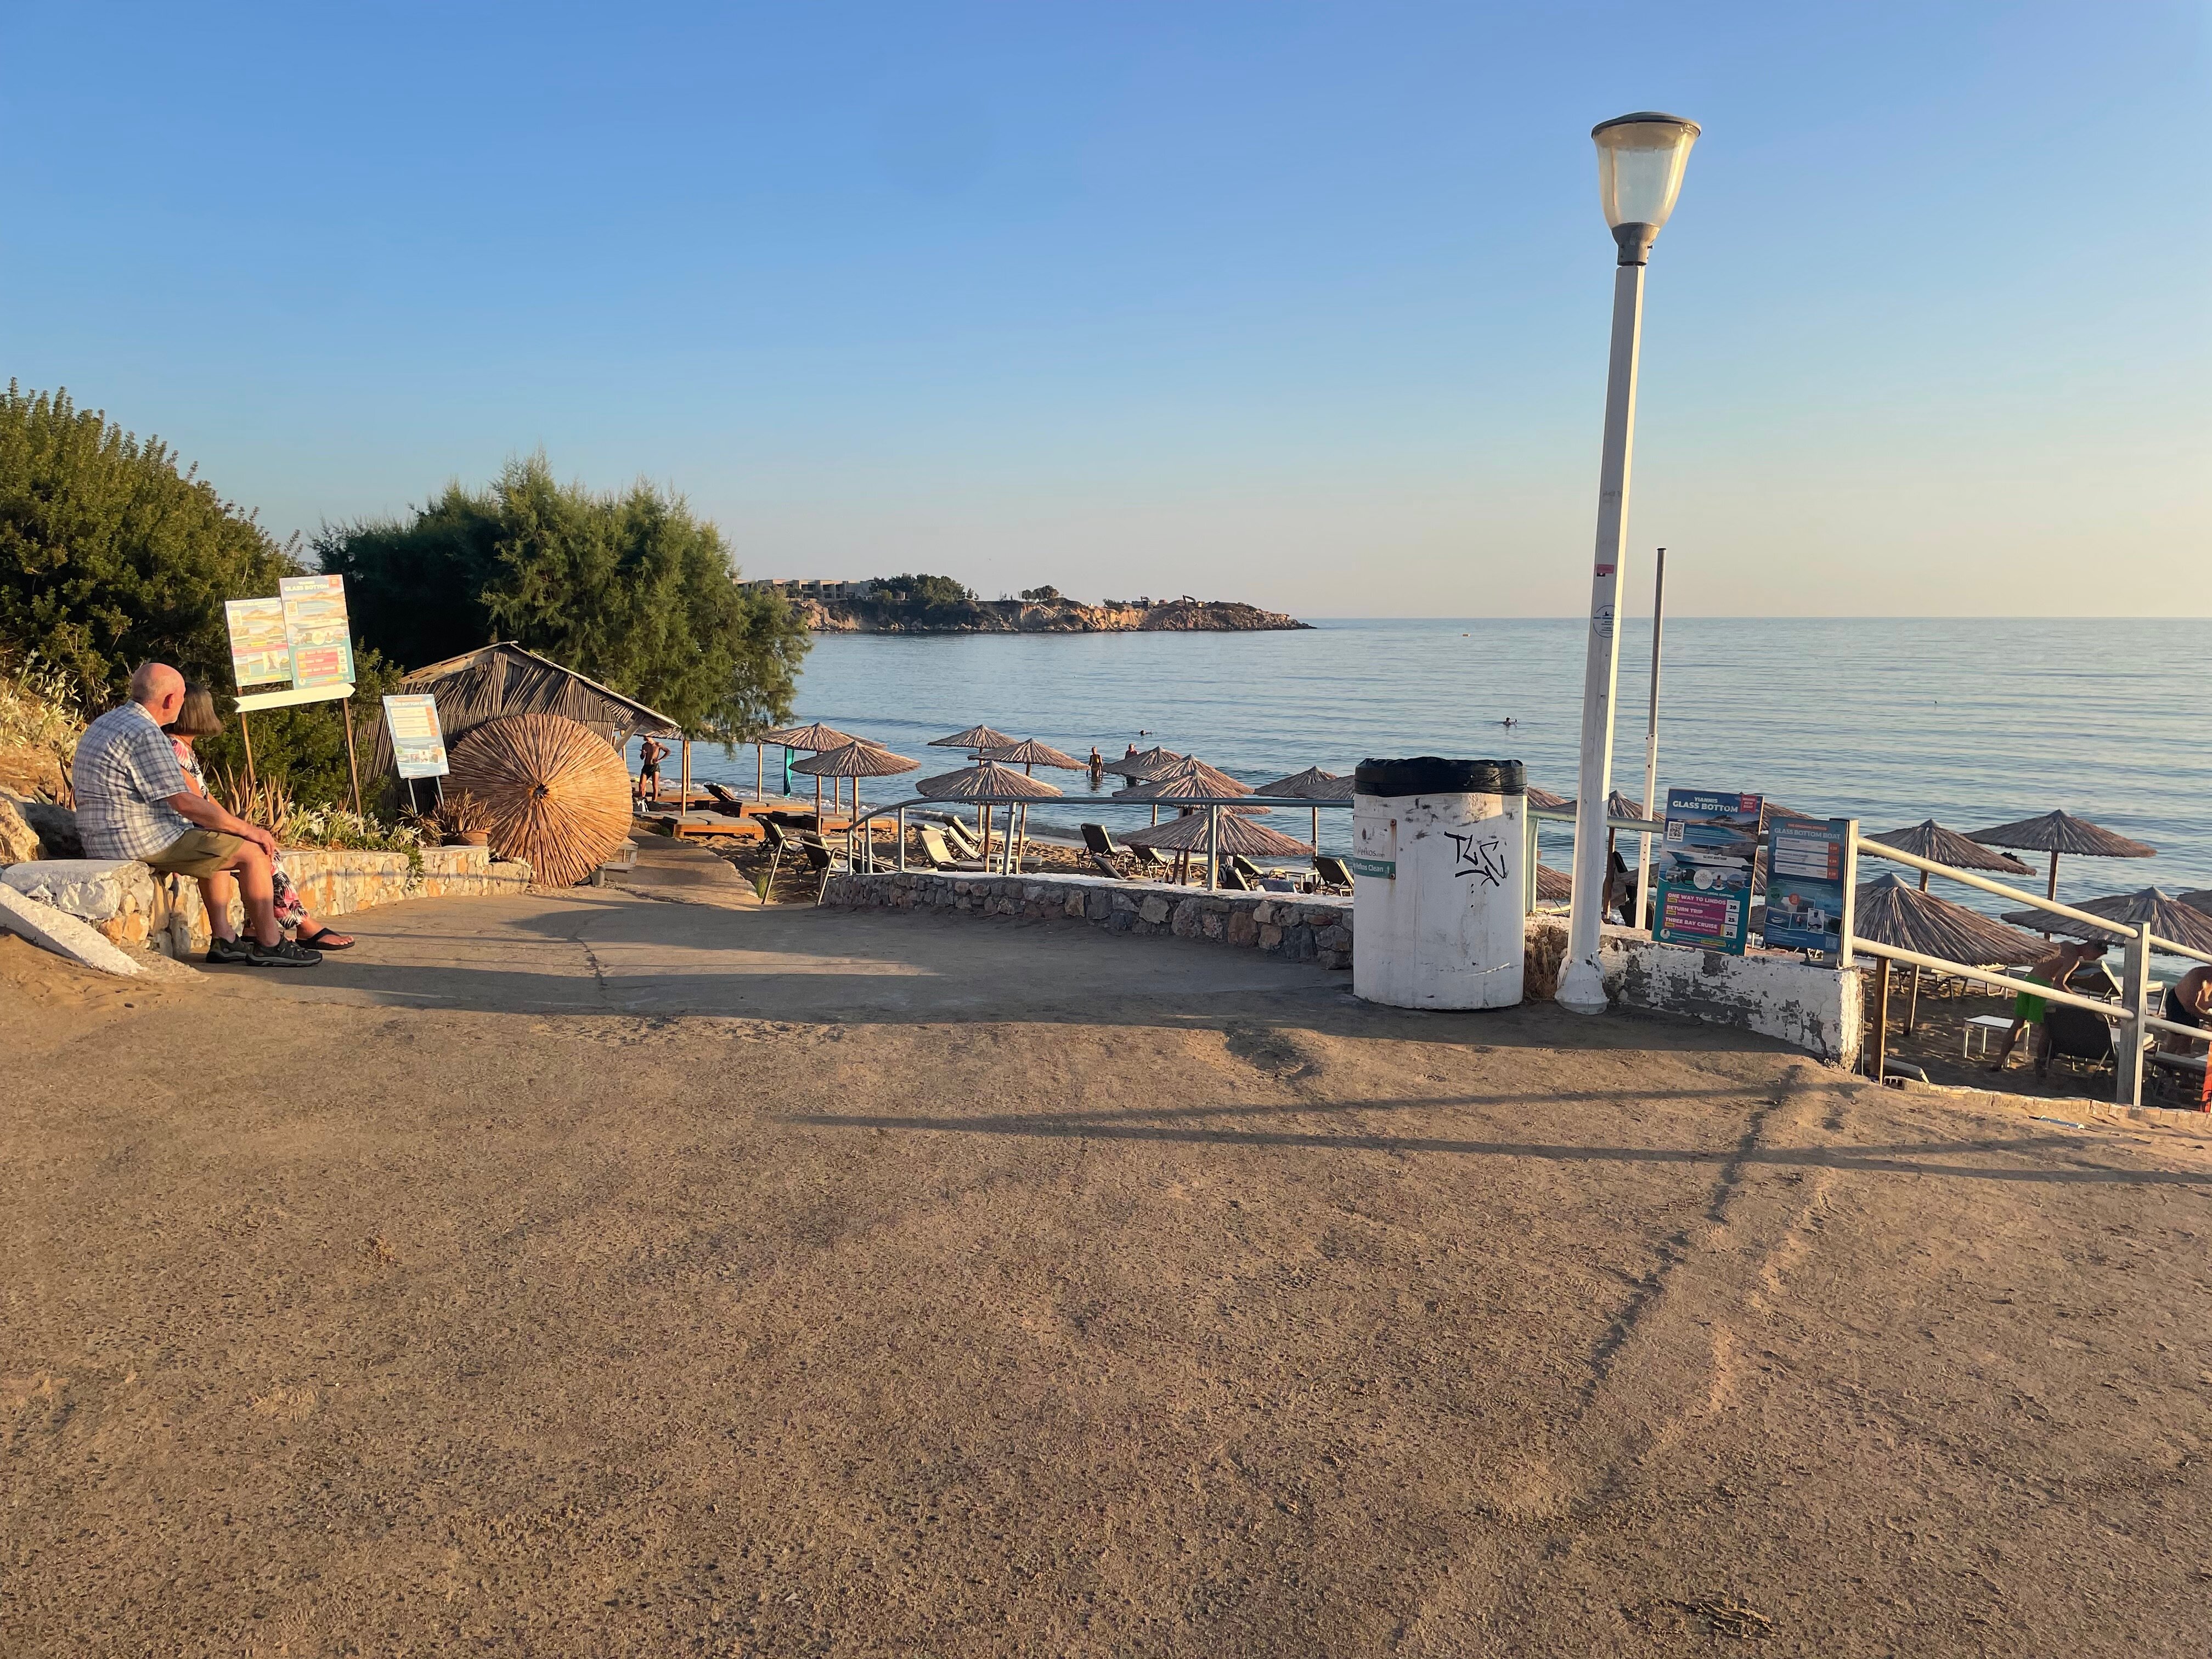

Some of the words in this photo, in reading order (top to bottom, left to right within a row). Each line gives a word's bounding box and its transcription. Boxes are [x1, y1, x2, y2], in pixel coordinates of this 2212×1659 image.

[1673, 800, 1700, 809] GLASS
[1701, 803, 1739, 813] BOTTOM
[1794, 830, 1822, 838] BOTTOM
[1368, 864, 1384, 872] Clean
